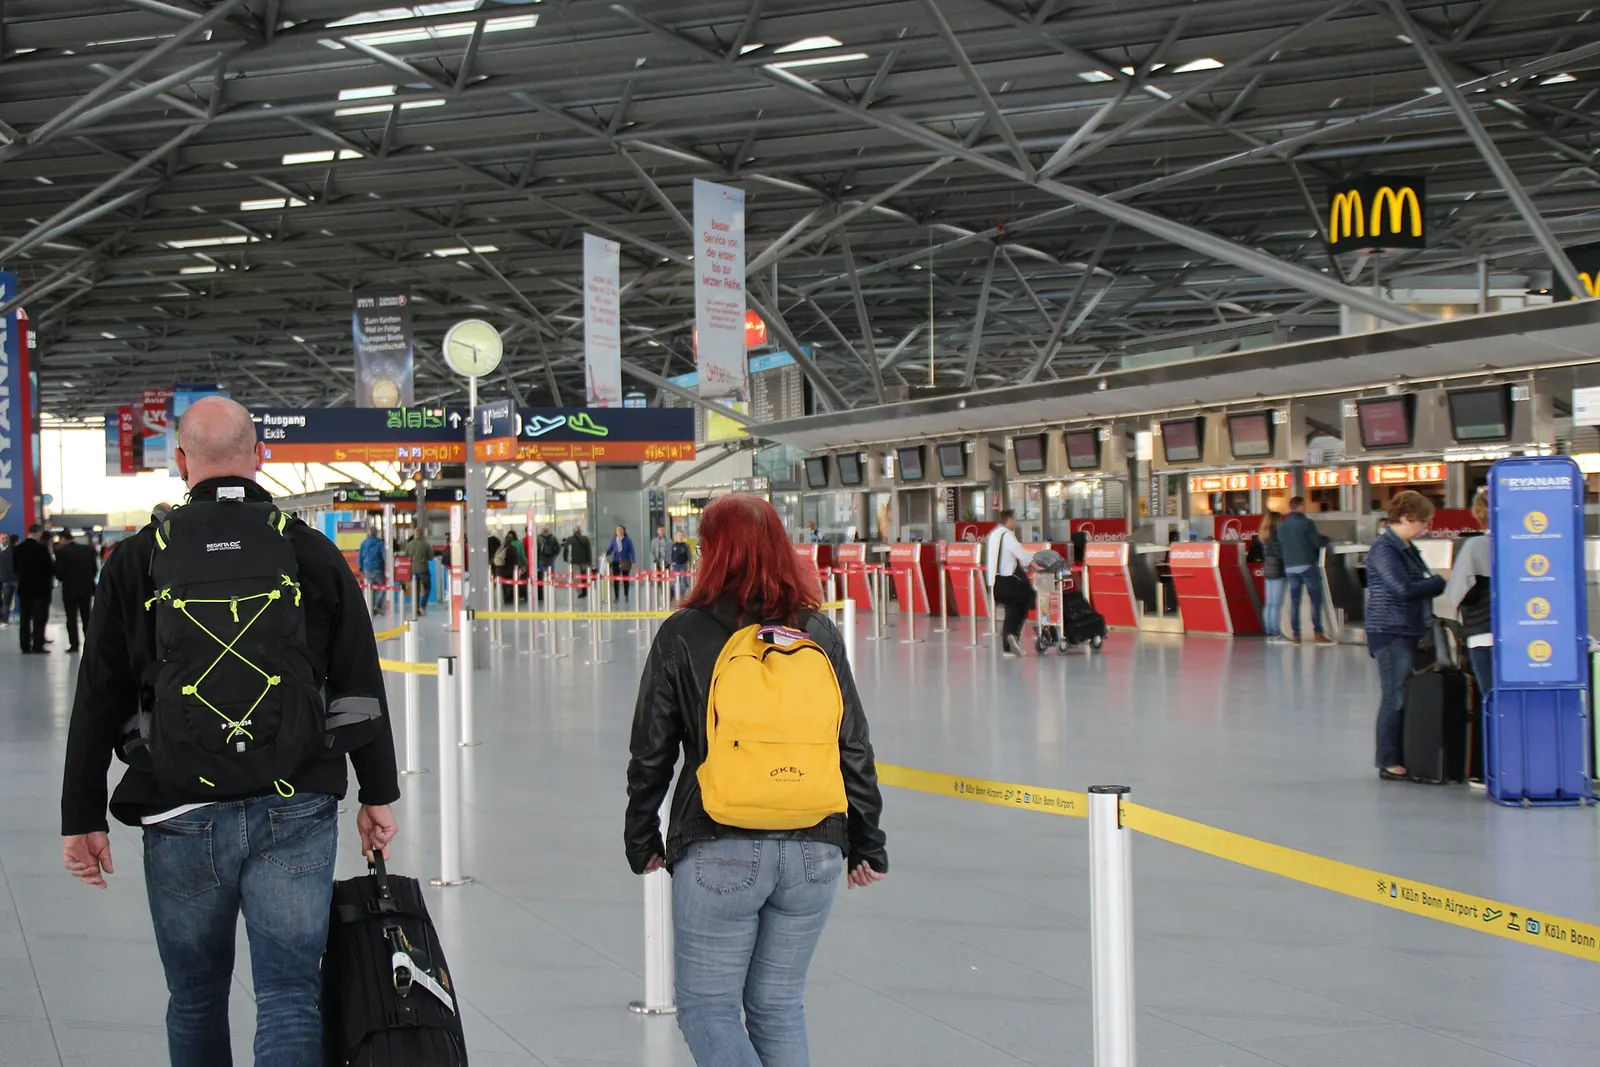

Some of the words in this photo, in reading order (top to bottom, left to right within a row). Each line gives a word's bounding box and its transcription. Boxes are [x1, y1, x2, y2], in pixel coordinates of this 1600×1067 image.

[703, 231, 726, 246] Service
[706, 247, 717, 258] der
[718, 251, 737, 262] ersten
[702, 274, 722, 289] letzten
[364, 317, 379, 325] Zum
[380, 315, 402, 324] fünften
[384, 325, 401, 333] Folge
[263, 413, 306, 427] Ausgang
[264, 428, 286, 439] Exit
[1508, 476, 1572, 487] RYANAIR
[976, 785, 986, 795] Bonn
[987, 787, 1003, 799] Airport
[1043, 795, 1055, 806] Bonn
[1056, 797, 1075, 809] Airport
[1401, 886, 1419, 903] Köln
[1422, 891, 1443, 909] Bonn
[1445, 897, 1478, 918] Airport
[1545, 922, 1567, 941] Köln
[1571, 928, 1596, 949] Bonn
